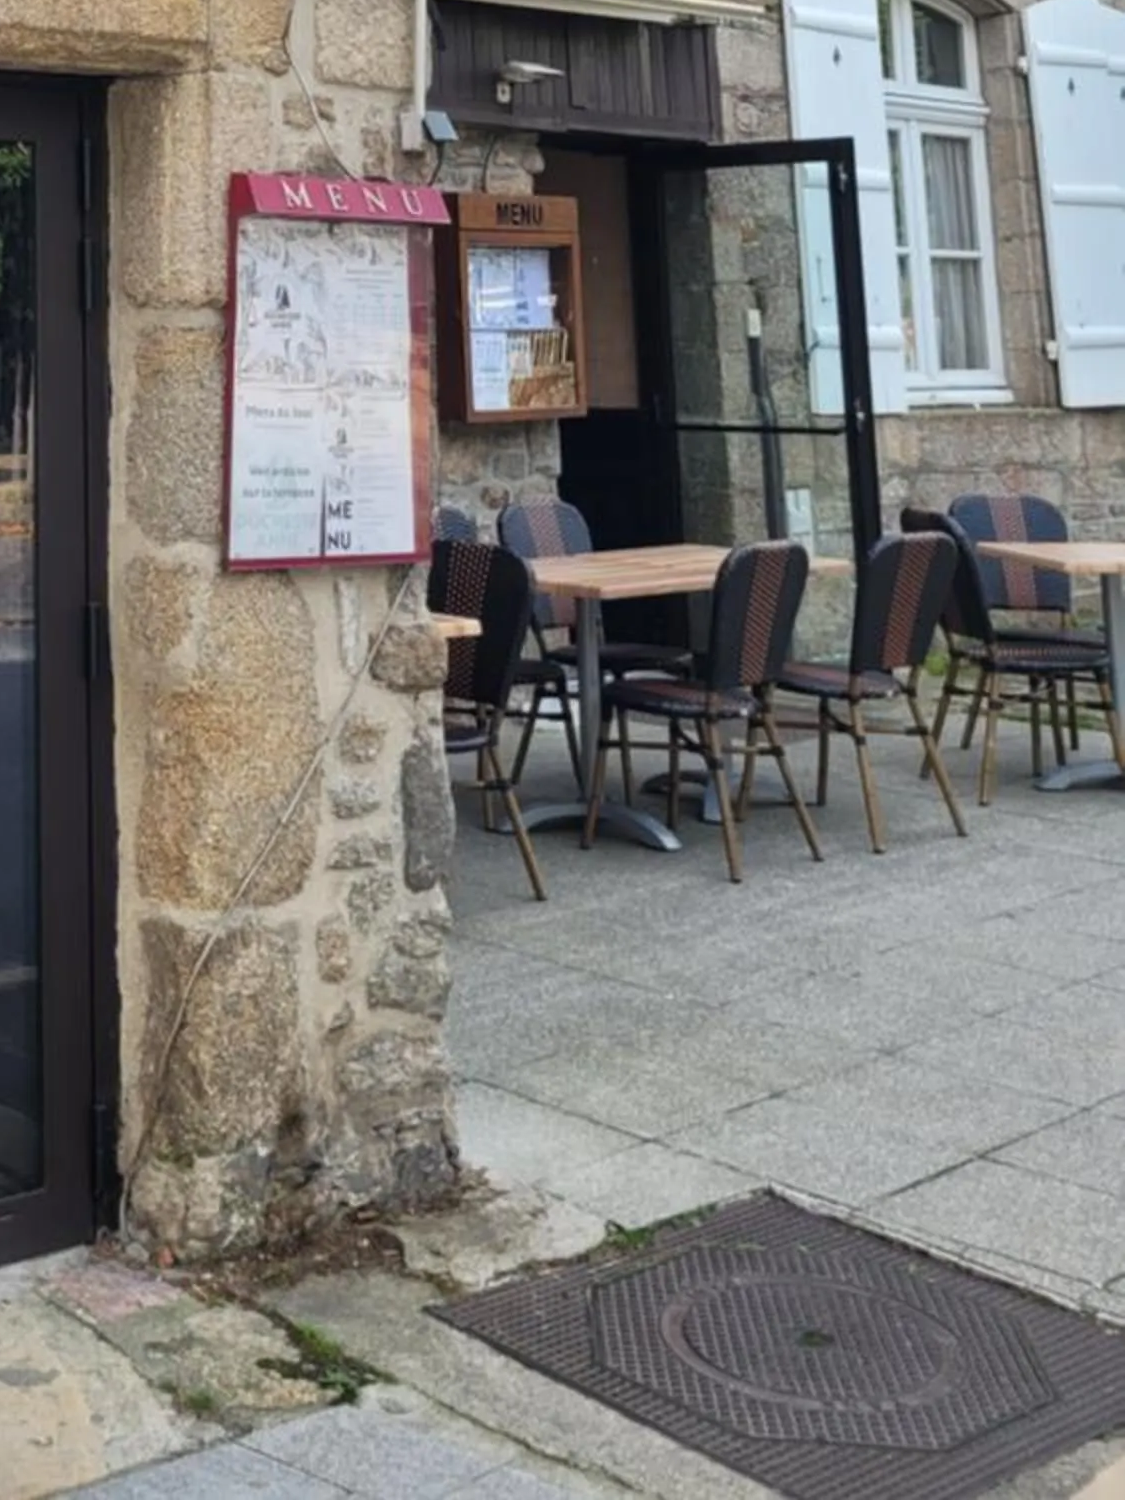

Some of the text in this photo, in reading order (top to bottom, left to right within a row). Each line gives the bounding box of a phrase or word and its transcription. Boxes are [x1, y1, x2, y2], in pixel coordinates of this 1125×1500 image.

[280, 179, 423, 215] MENU
[496, 202, 543, 227] MENU
[328, 500, 354, 520] ME
[327, 531, 352, 550] NU
